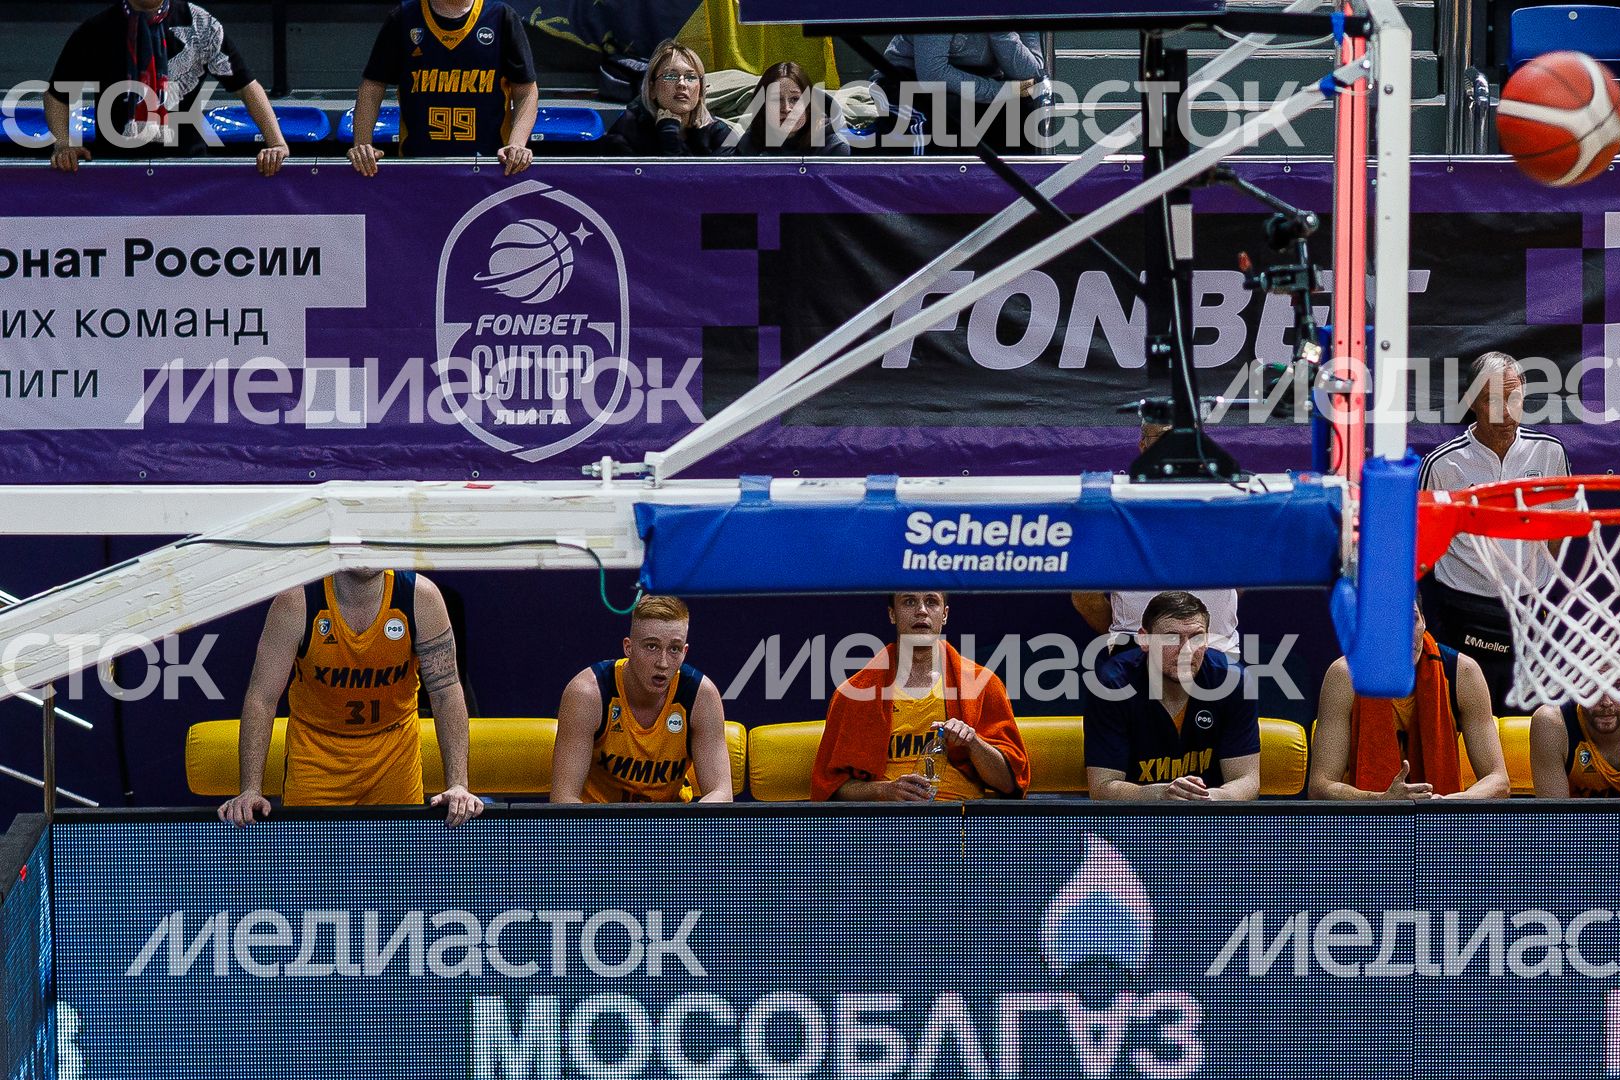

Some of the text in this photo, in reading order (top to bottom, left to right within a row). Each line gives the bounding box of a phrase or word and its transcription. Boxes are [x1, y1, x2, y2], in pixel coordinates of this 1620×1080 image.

[410, 68, 496, 94] ХИМКИ
[428, 106, 476, 141] 99
[124, 237, 322, 277] России
[75, 307, 269, 346] команд
[475, 314, 589, 336] FONBET
[493, 408, 572, 426] ЛИГА
[904, 510, 1074, 548] Schelde
[902, 548, 1069, 573] International
[313, 659, 410, 690] ХИМКИ
[343, 699, 381, 725] 31
[599, 750, 687, 785] ХИМКИ
